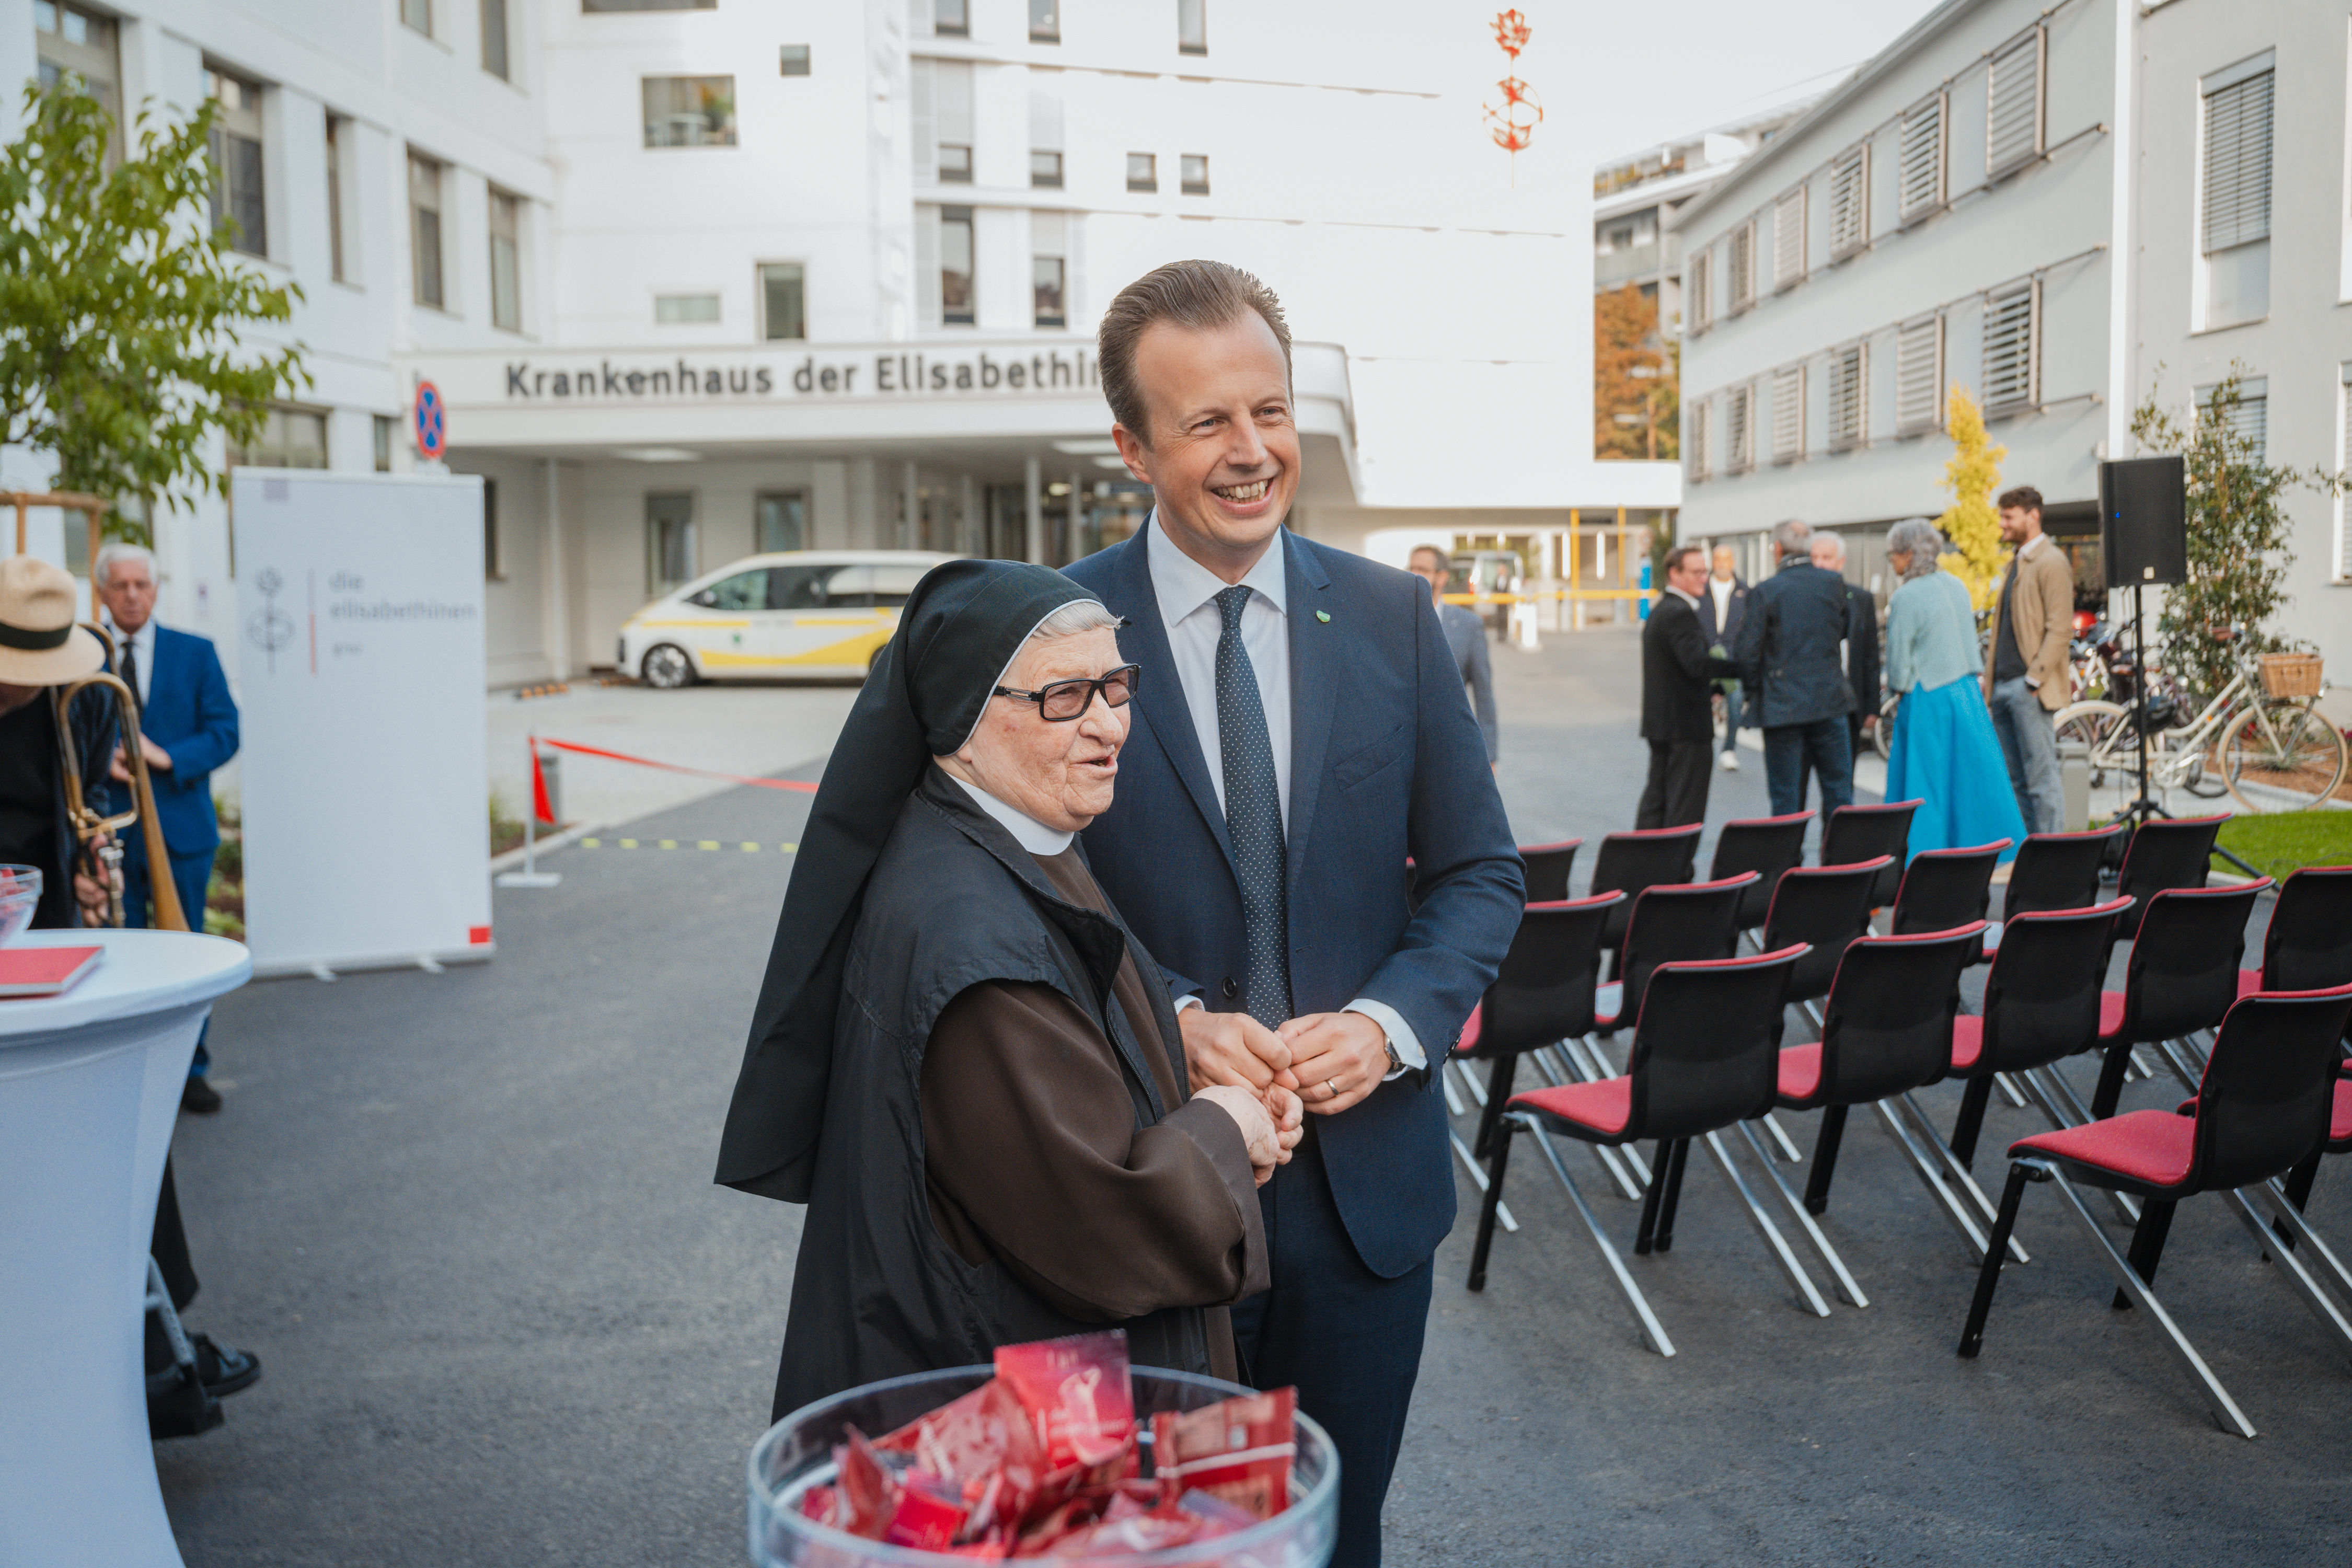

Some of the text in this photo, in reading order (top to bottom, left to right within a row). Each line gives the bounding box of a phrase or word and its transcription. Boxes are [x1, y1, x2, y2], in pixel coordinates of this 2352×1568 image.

[507, 358, 772, 397] Krankenhaus
[793, 356, 857, 393] der
[329, 571, 363, 591] die
